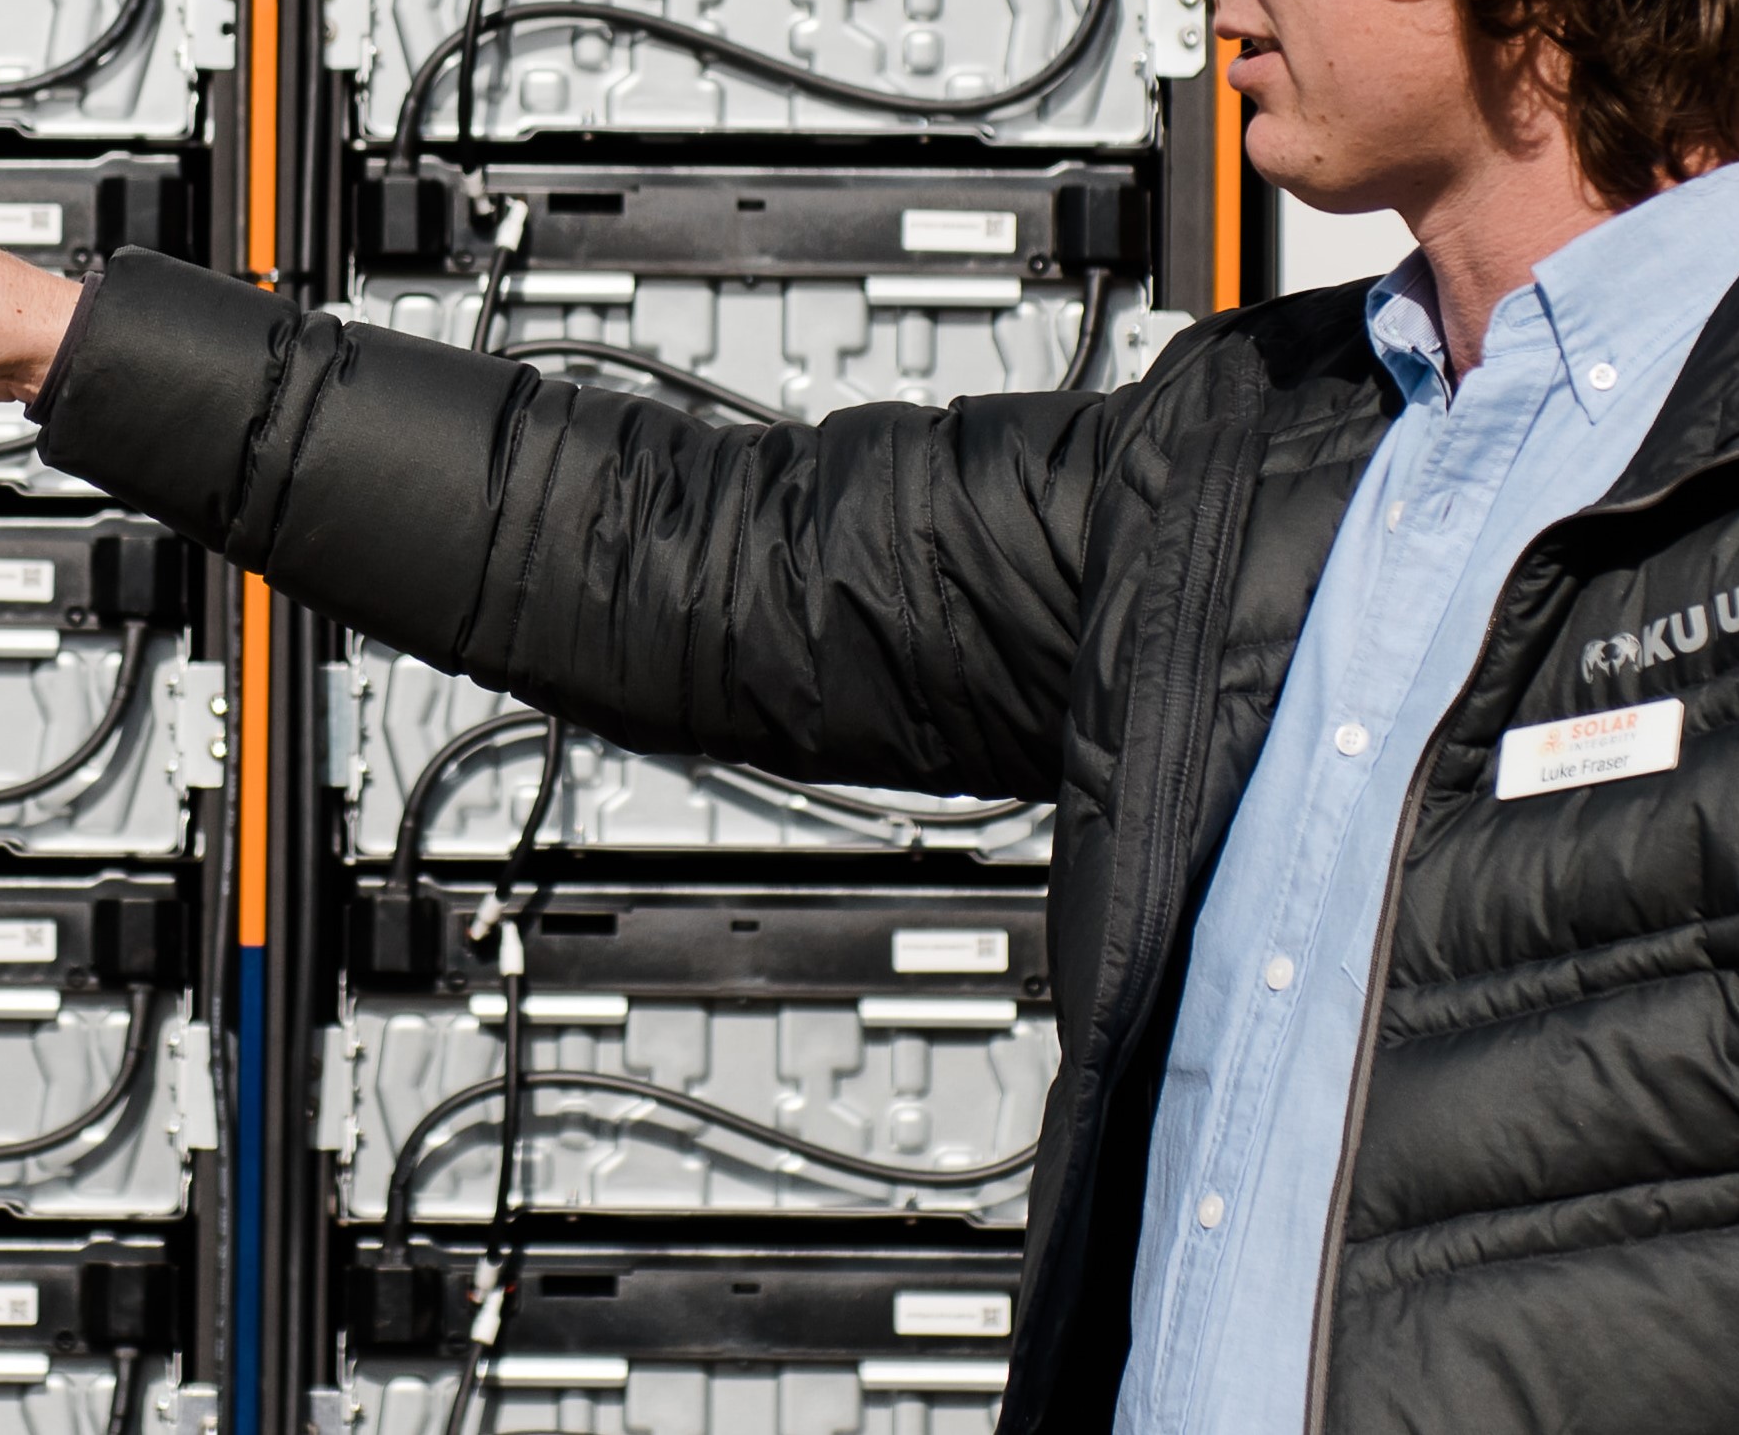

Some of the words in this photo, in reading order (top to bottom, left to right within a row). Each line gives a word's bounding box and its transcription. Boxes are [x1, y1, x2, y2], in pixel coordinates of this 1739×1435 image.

[1572, 712, 1637, 740] SOLAR
[1541, 762, 1578, 783] Luke
[1581, 755, 1631, 775] Fraser
